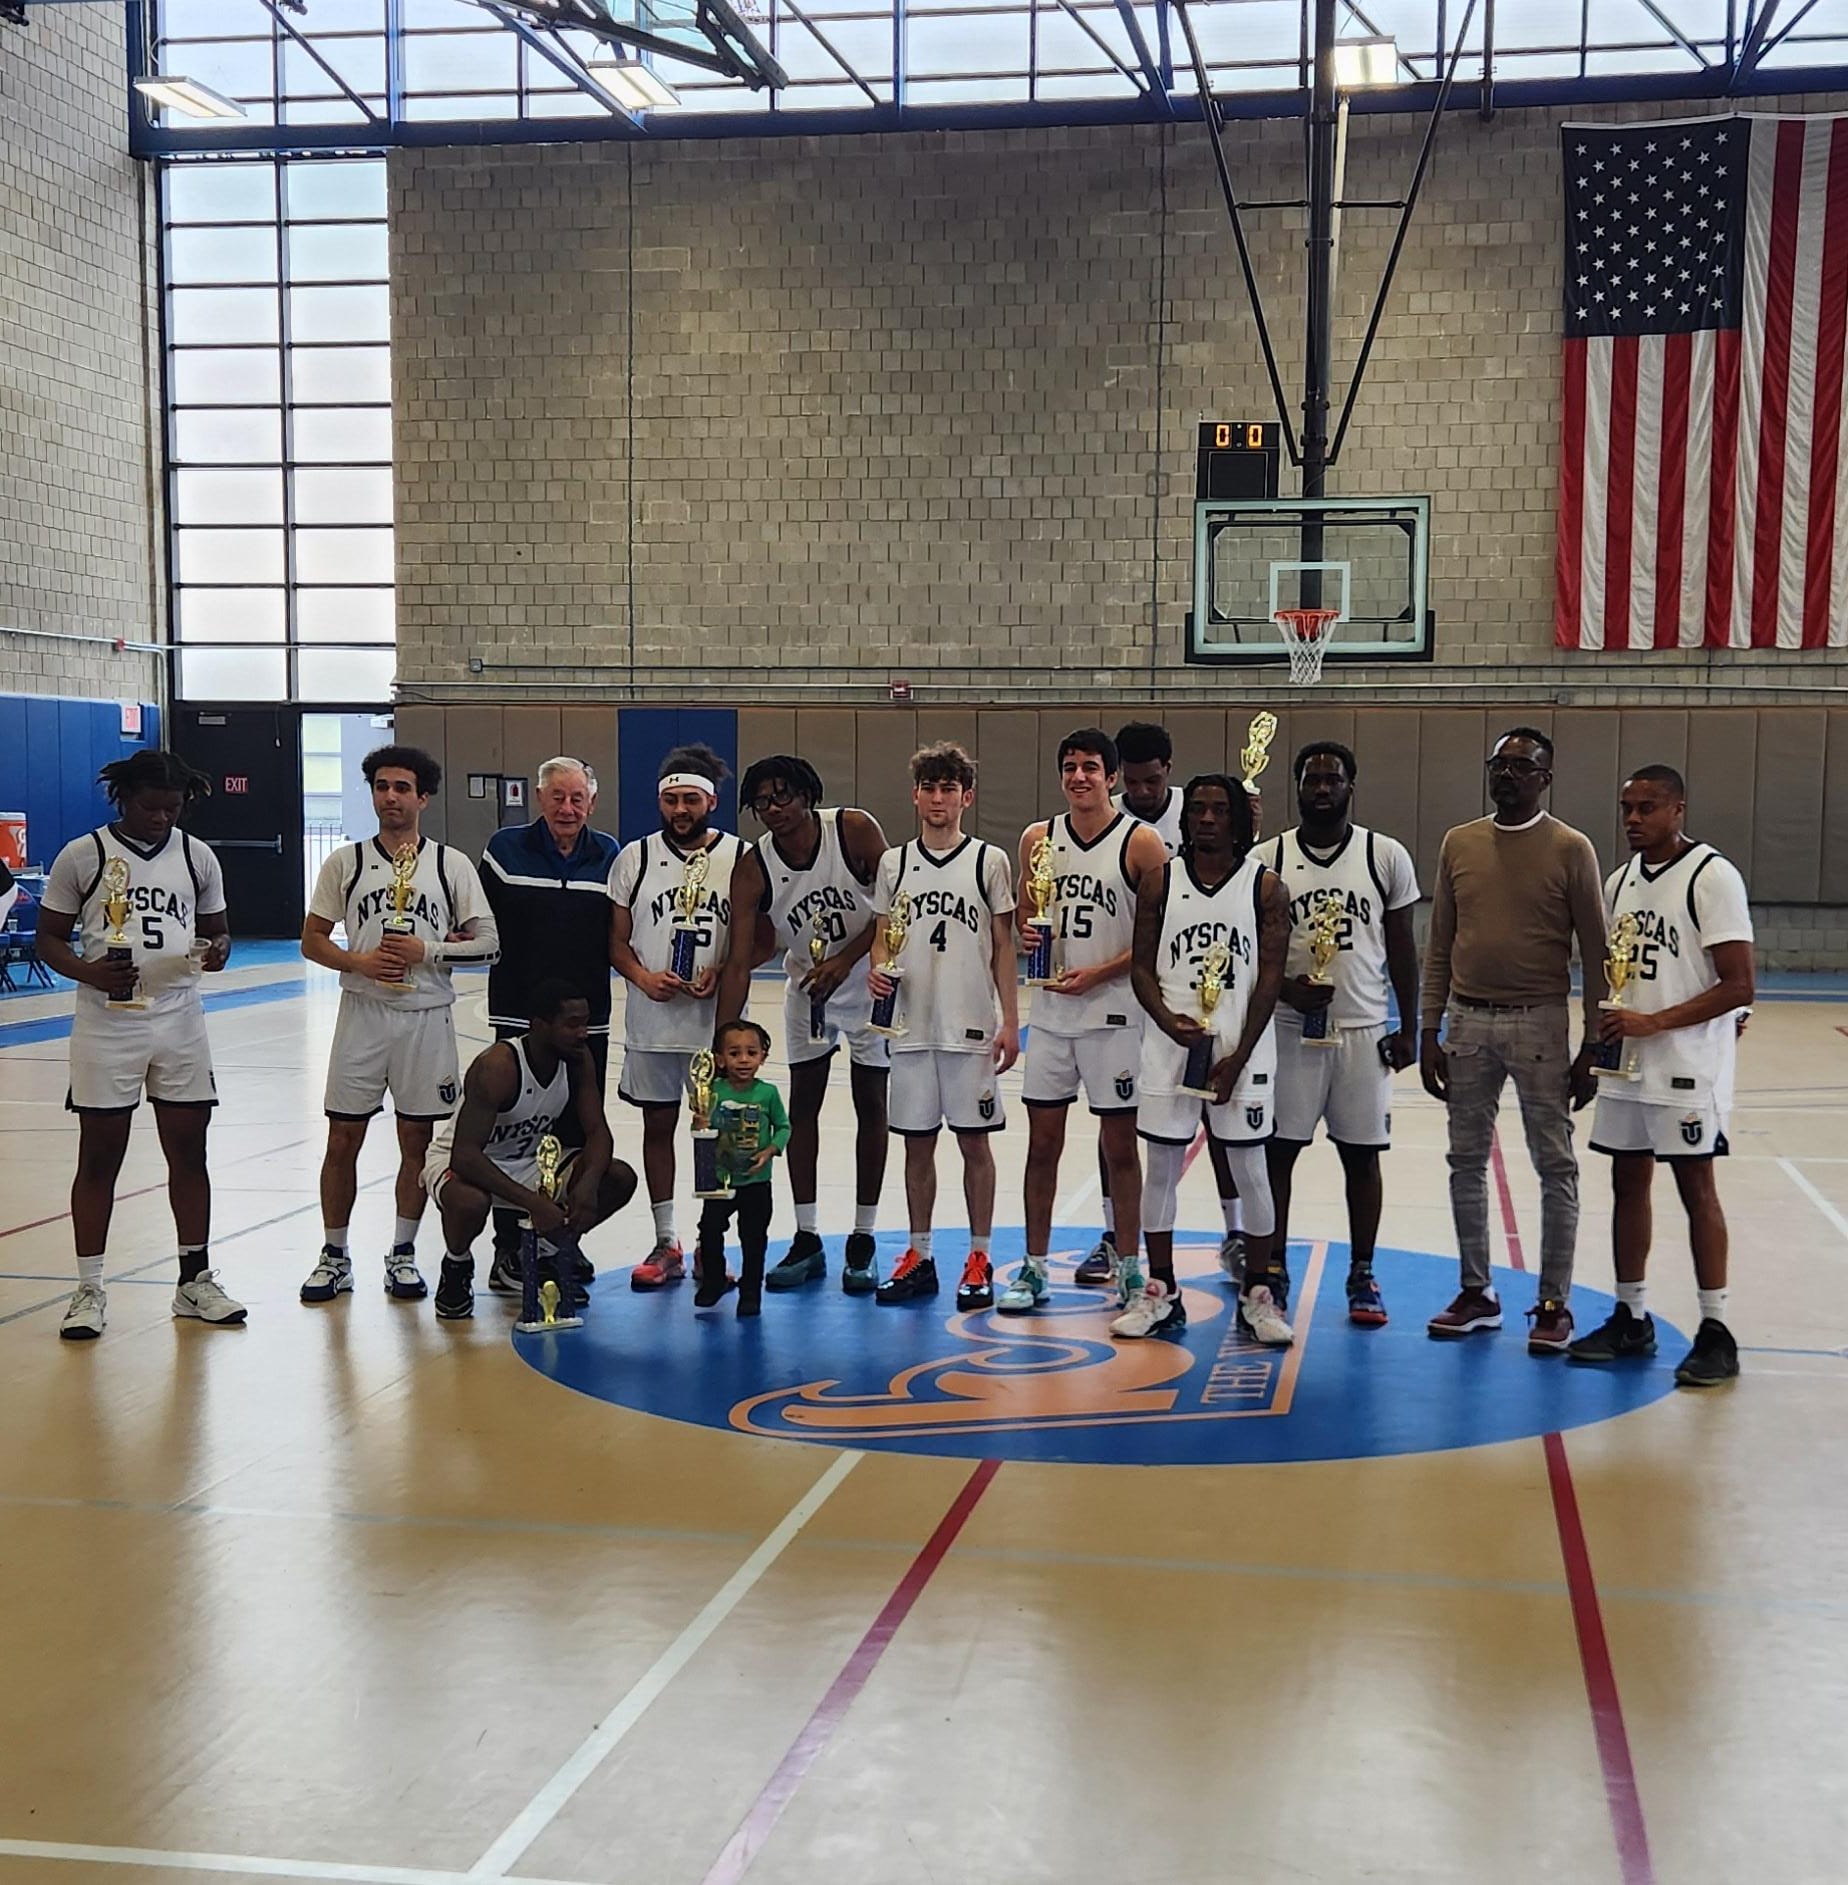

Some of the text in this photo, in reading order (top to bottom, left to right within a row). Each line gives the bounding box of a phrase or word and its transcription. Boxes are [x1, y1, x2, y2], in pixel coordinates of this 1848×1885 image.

[1216, 424, 1262, 447] 0 0
[225, 777, 248, 792] EXIT
[103, 886, 188, 930] SCAS
[651, 886, 731, 926] NYAS
[787, 886, 856, 936] NYSCAS
[1046, 874, 1117, 917] YSCAS
[141, 916, 164, 950] 5
[930, 920, 946, 952] 4
[1060, 905, 1094, 938] 15
[1200, 1361, 1273, 1404] THE
